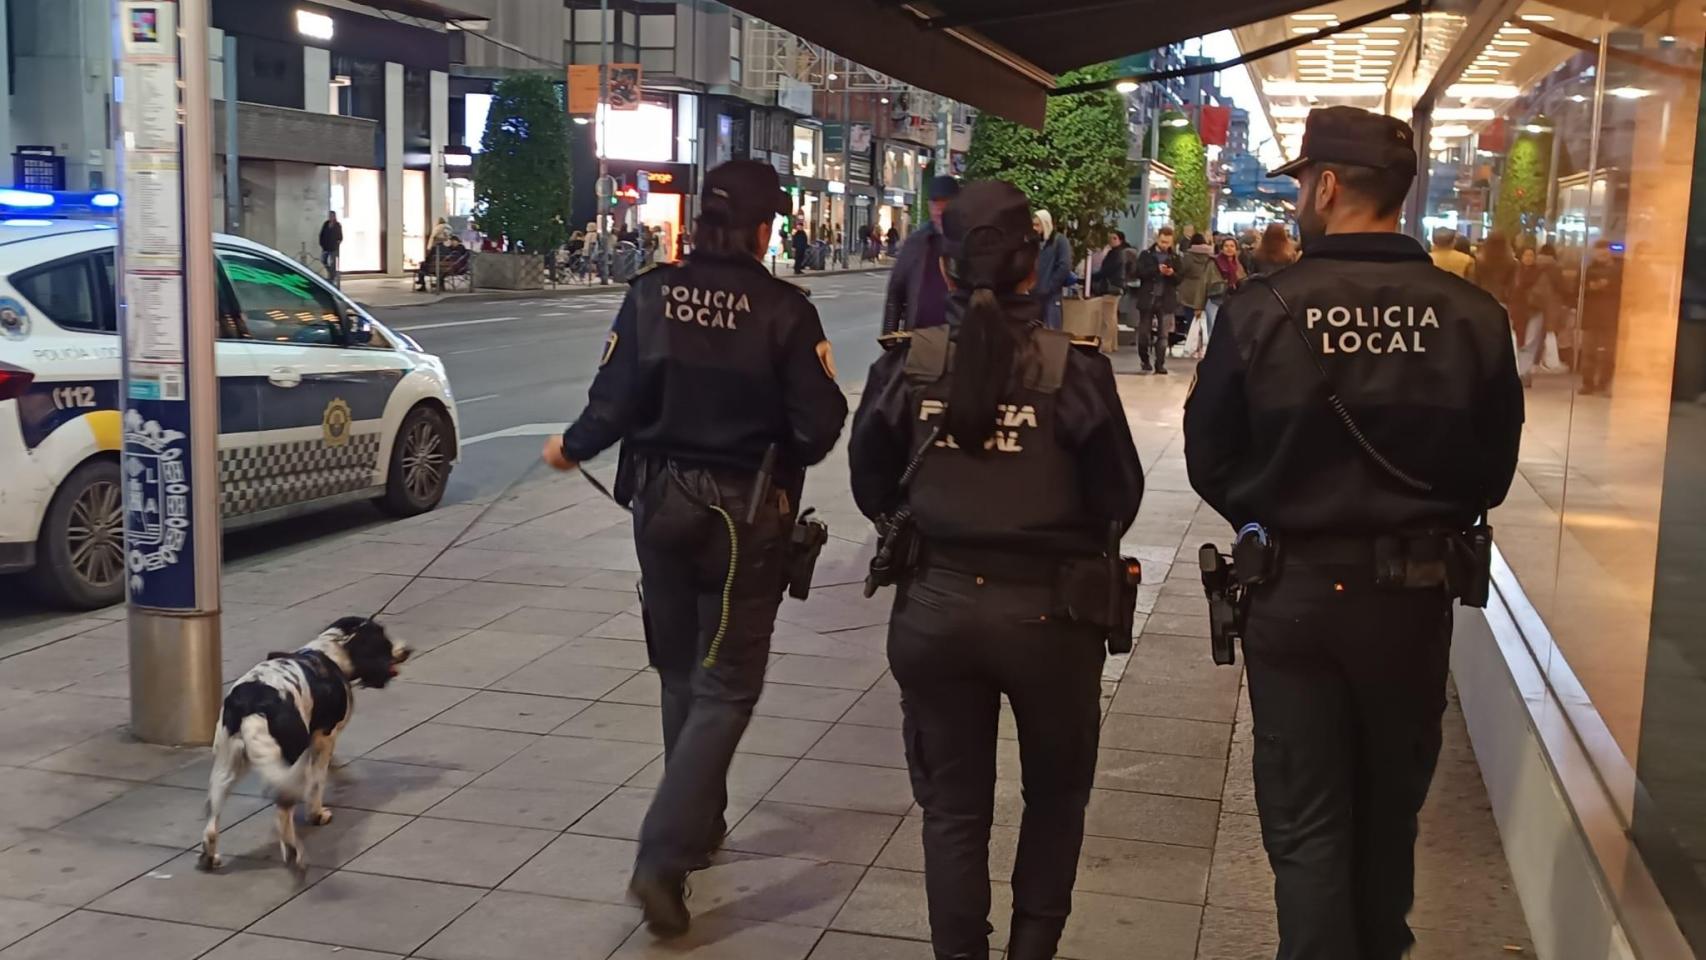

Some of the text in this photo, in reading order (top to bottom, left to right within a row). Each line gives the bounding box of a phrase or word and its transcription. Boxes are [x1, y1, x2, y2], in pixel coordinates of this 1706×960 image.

[661, 284, 751, 312] POLICIA
[665, 301, 736, 330] LOCAL
[1306, 305, 1439, 329] POLICIA
[1322, 331, 1426, 354] LOCAL
[60, 386, 97, 408] 112
